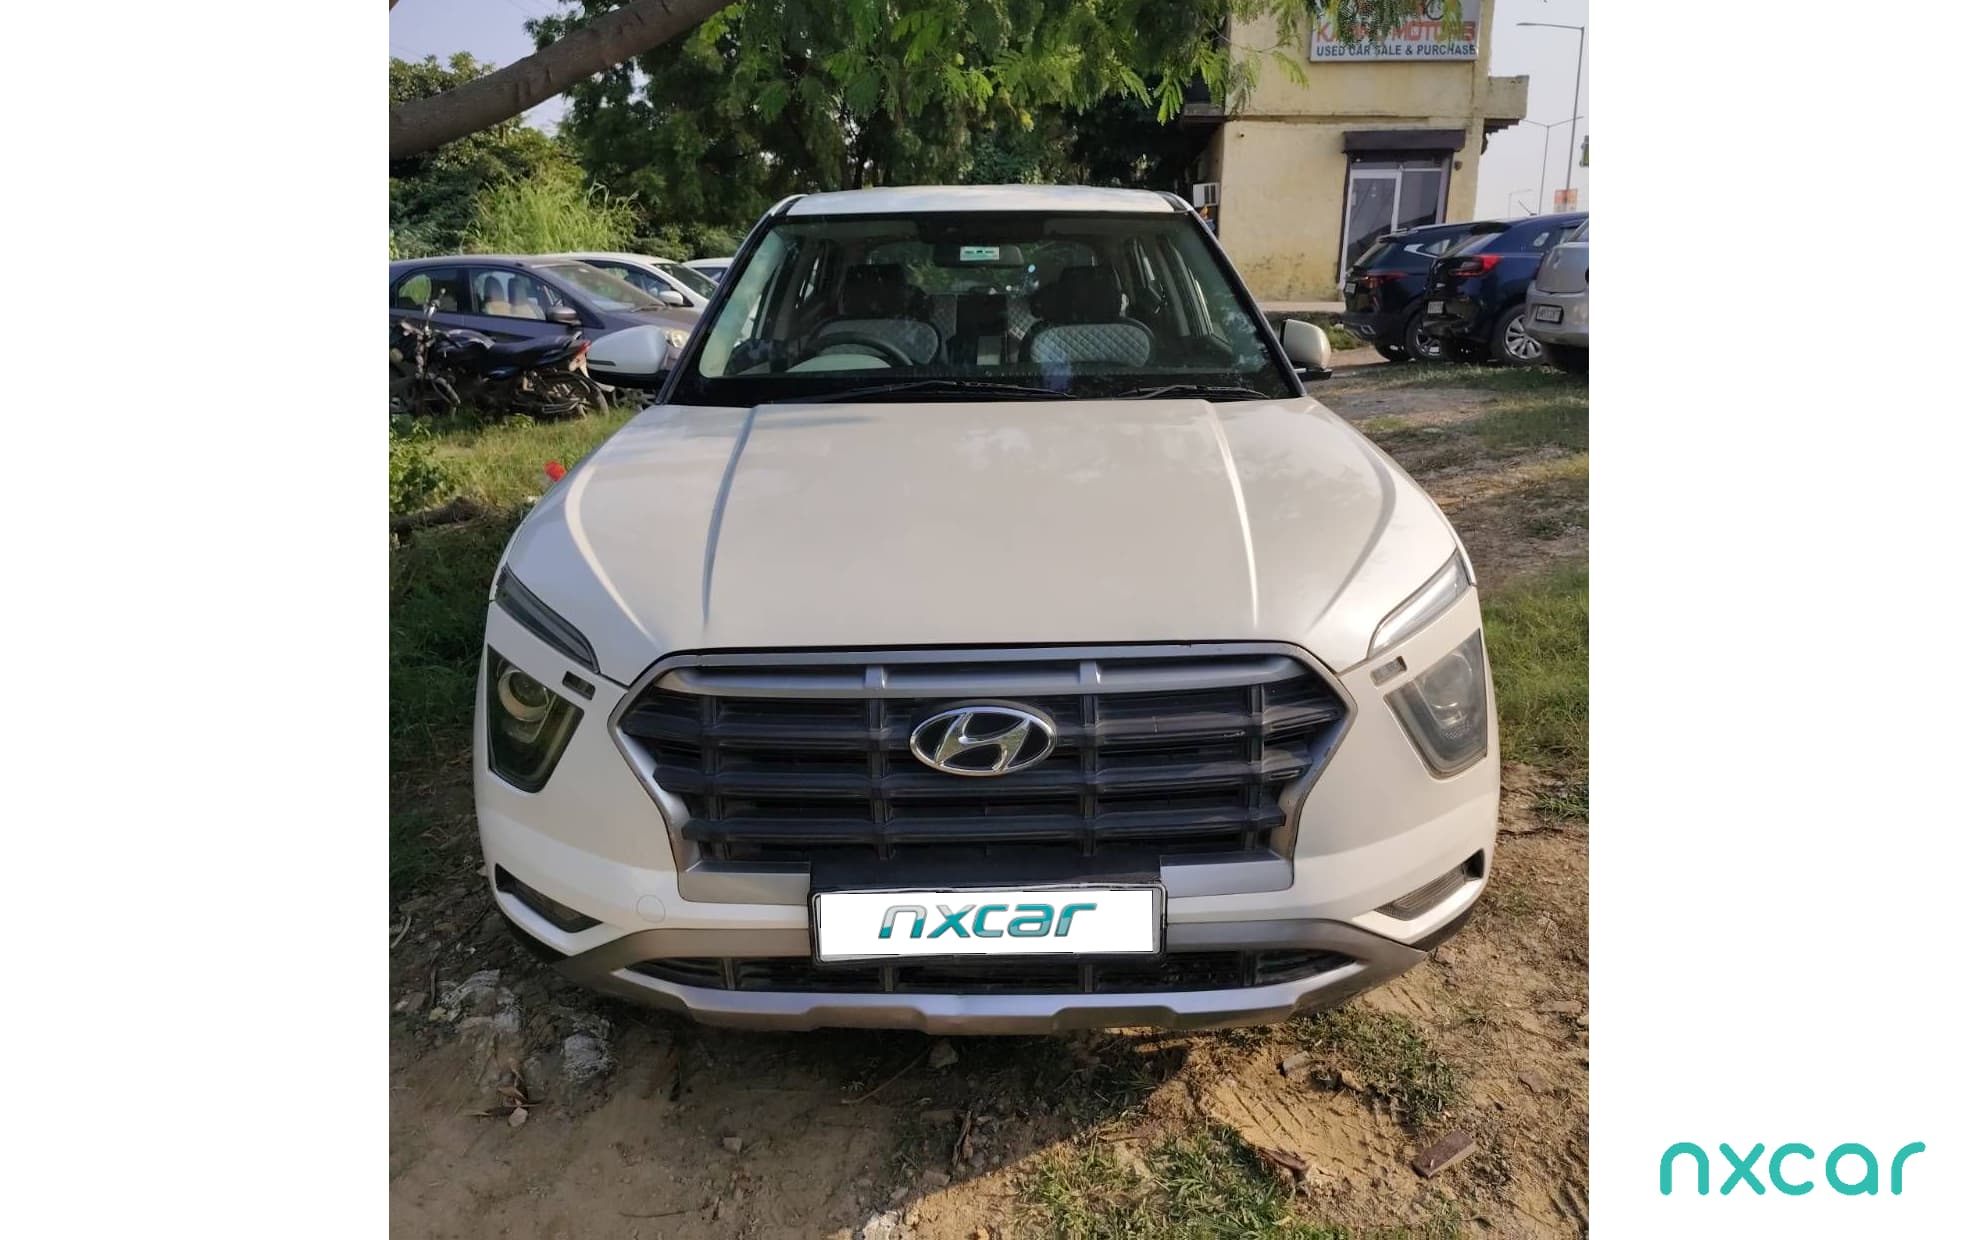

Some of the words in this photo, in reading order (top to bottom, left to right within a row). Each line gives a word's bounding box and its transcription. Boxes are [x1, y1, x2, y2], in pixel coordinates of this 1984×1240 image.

[1316, 44, 1345, 57] USED
[1348, 44, 1370, 56] CAR
[1405, 44, 1413, 55] &
[1417, 44, 1477, 56] PURCHASE
